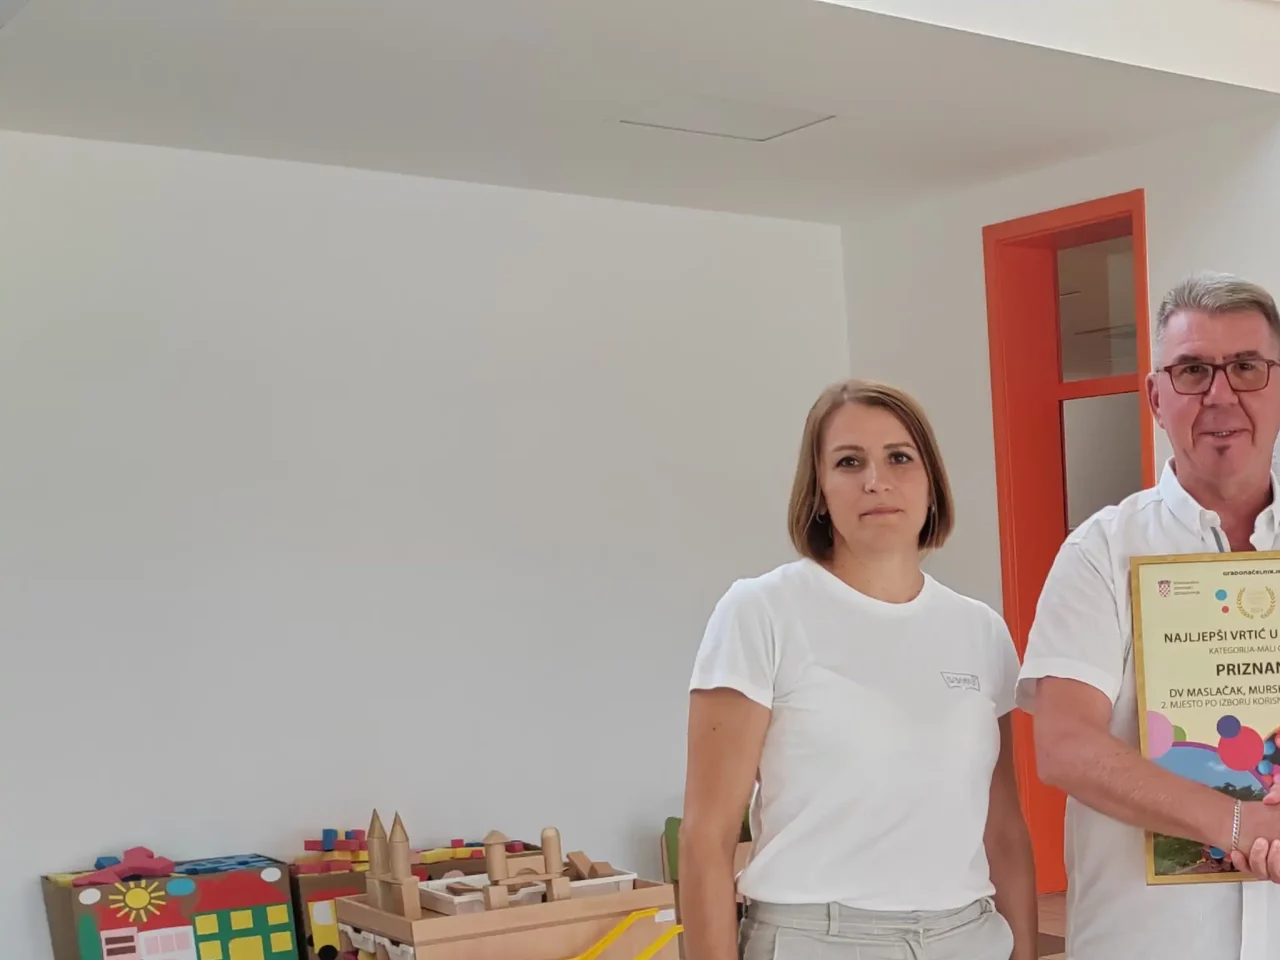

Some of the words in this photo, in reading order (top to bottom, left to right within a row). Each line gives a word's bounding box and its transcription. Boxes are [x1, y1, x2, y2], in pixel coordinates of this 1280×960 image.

[1164, 628, 1228, 643] NAJLJEPŠI
[1230, 627, 1266, 641] VRTIĆ
[1269, 628, 1278, 639] U
[1169, 688, 1184, 698] DV
[1187, 685, 1246, 697] MASLAČAK,
[1170, 699, 1203, 709] MJESTO
[1205, 699, 1218, 707] PO
[1220, 698, 1251, 707] IZBORU
